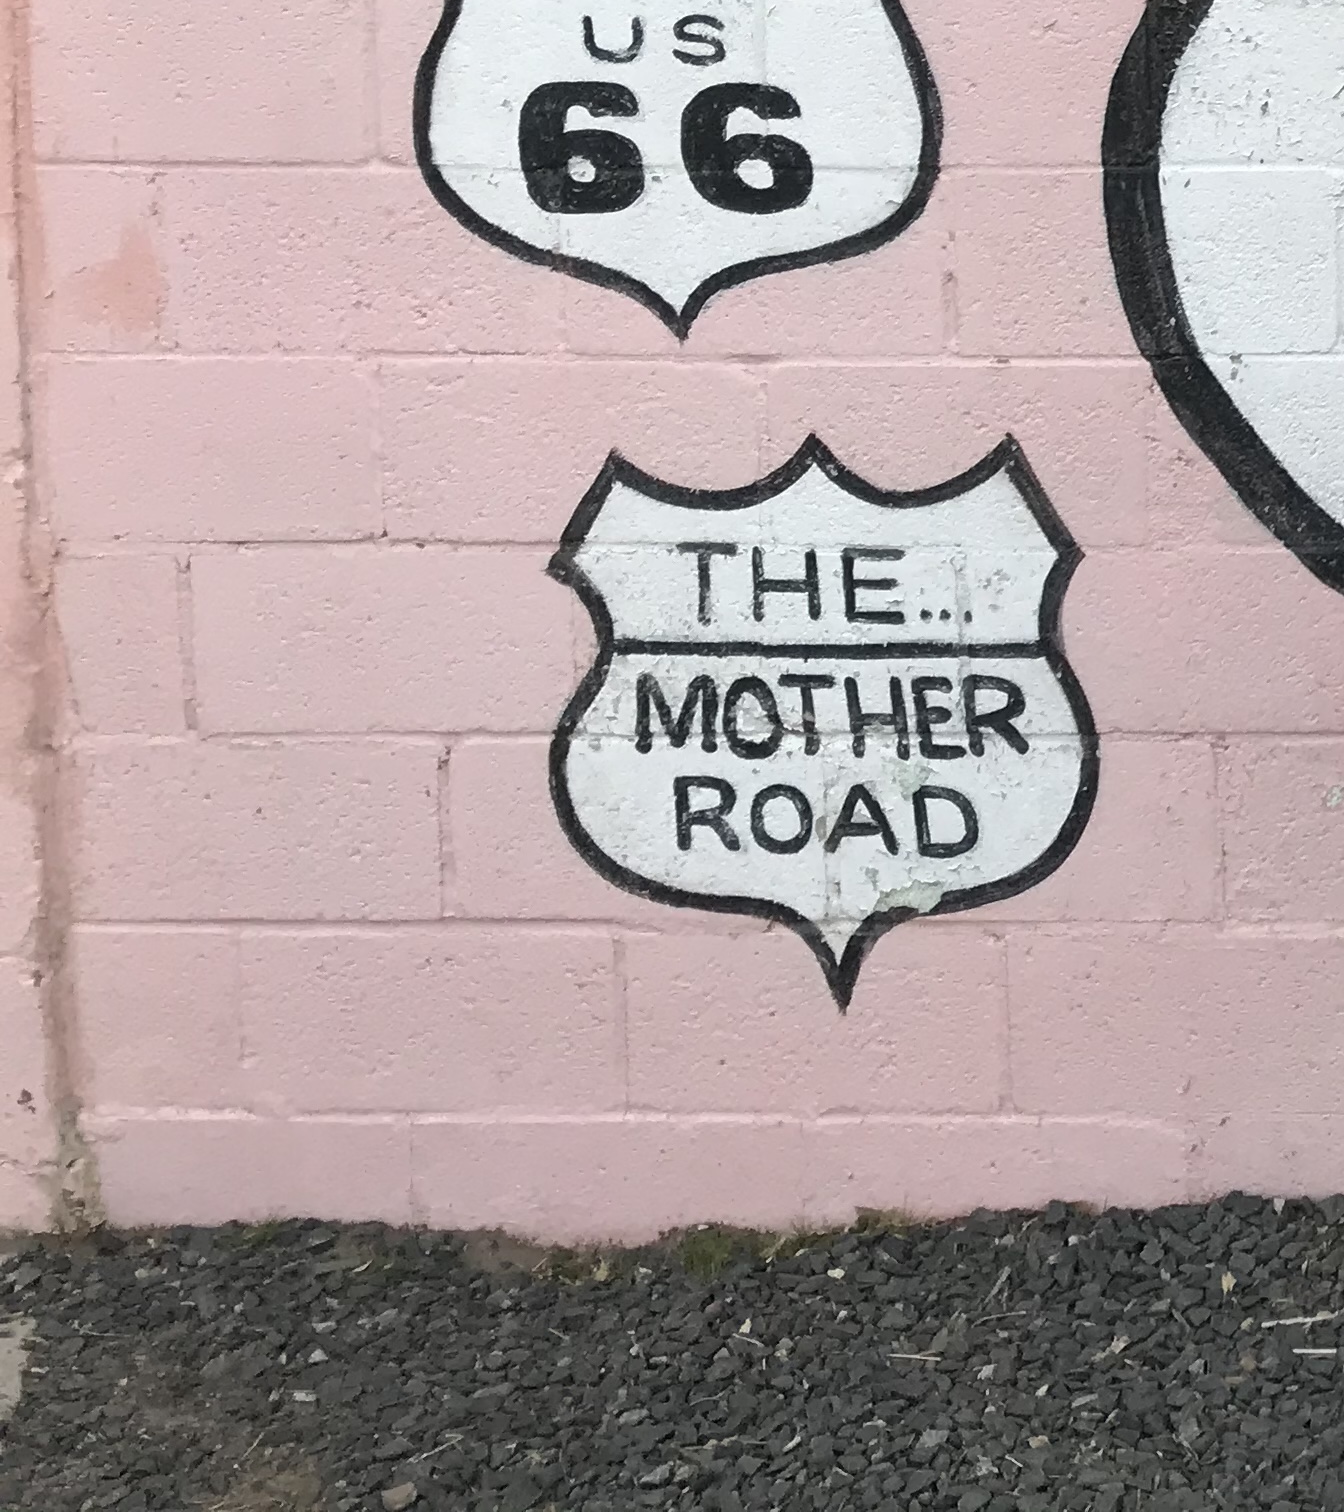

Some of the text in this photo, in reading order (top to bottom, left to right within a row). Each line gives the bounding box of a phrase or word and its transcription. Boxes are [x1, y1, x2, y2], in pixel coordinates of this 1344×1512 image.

[518, 80, 814, 214] 66
[635, 674, 1031, 760] MOTHER
[673, 775, 979, 859] ROAD
